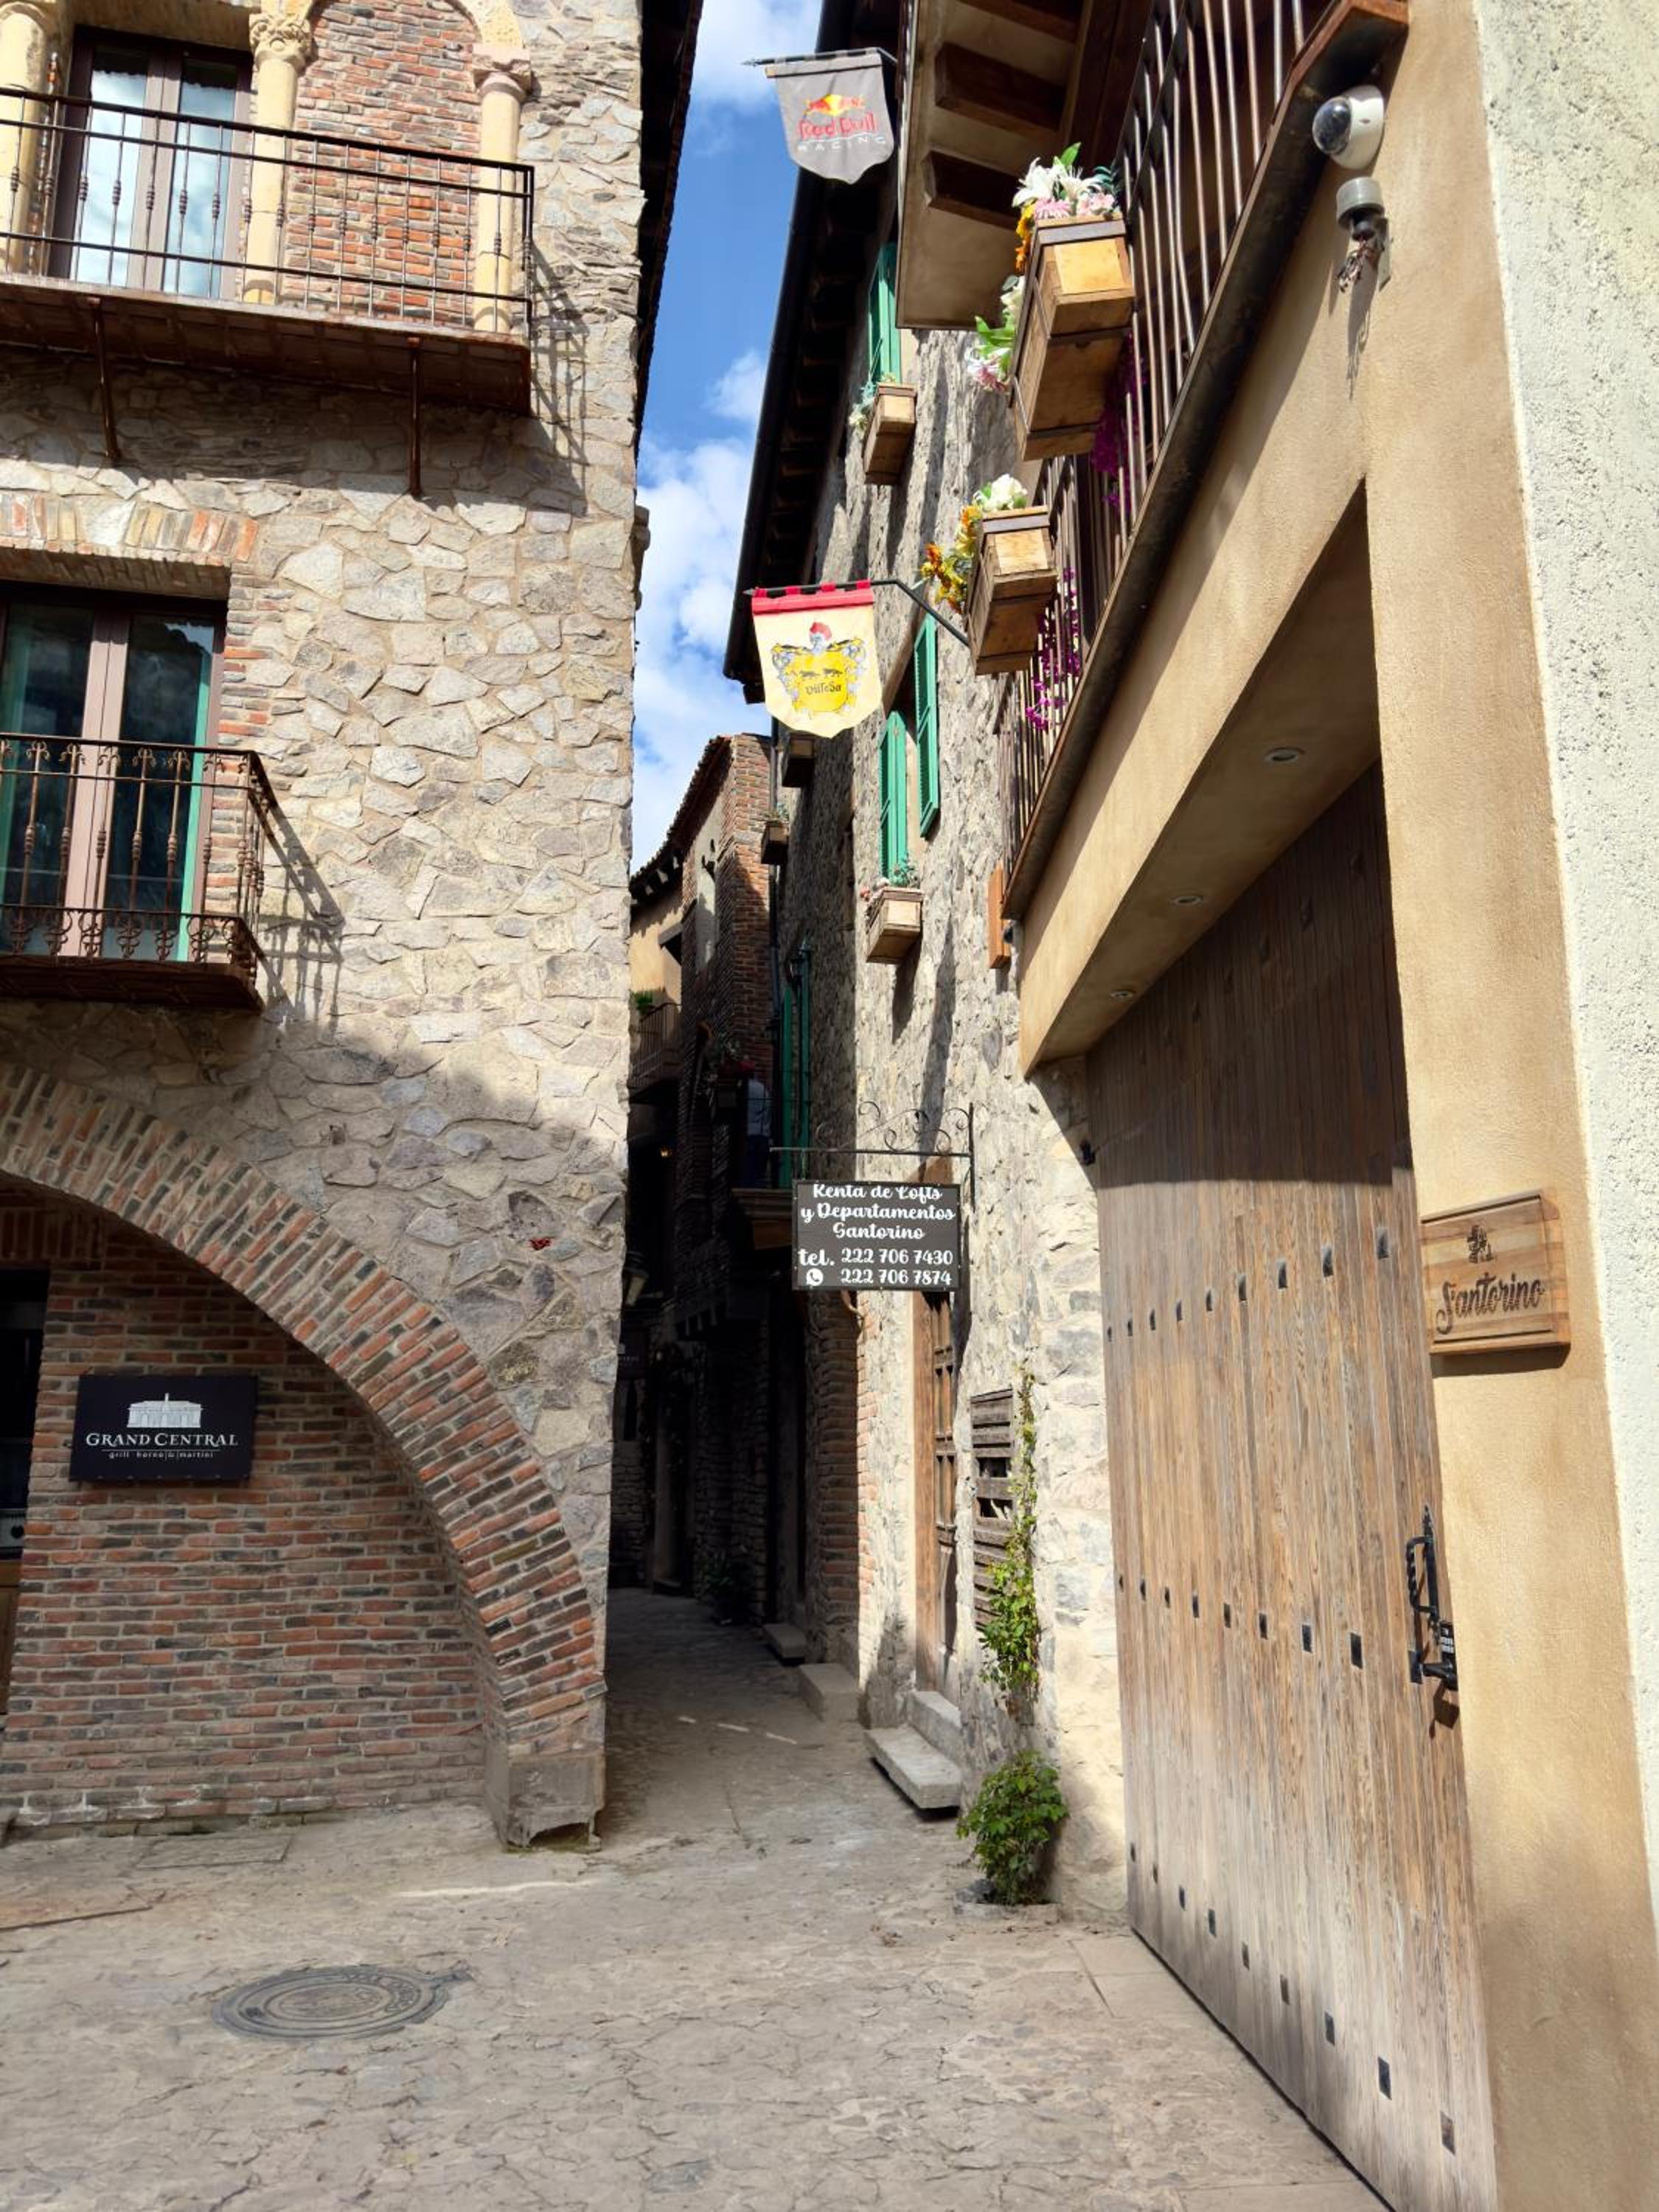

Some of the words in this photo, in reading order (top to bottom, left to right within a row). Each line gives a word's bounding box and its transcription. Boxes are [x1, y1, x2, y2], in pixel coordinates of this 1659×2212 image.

[799, 118, 836, 139] Red
[839, 111, 878, 136] Bull
[871, 1185, 893, 1199] de
[895, 1186, 943, 1204] Lofts
[801, 1207, 814, 1223] y
[817, 1203, 956, 1222] Departamentos
[832, 1222, 925, 1239] Santorino
[797, 1248, 835, 1266] tel.
[841, 1248, 874, 1263] 222
[878, 1249, 909, 1265] 706
[913, 1250, 954, 1265] 7430
[841, 1268, 874, 1284] 222
[878, 1269, 909, 1284] 706
[913, 1270, 953, 1286] 7874
[1436, 1272, 1545, 1335] Santorino
[86, 1433, 150, 1447] GRAND
[154, 1433, 239, 1447] CENTRAL
